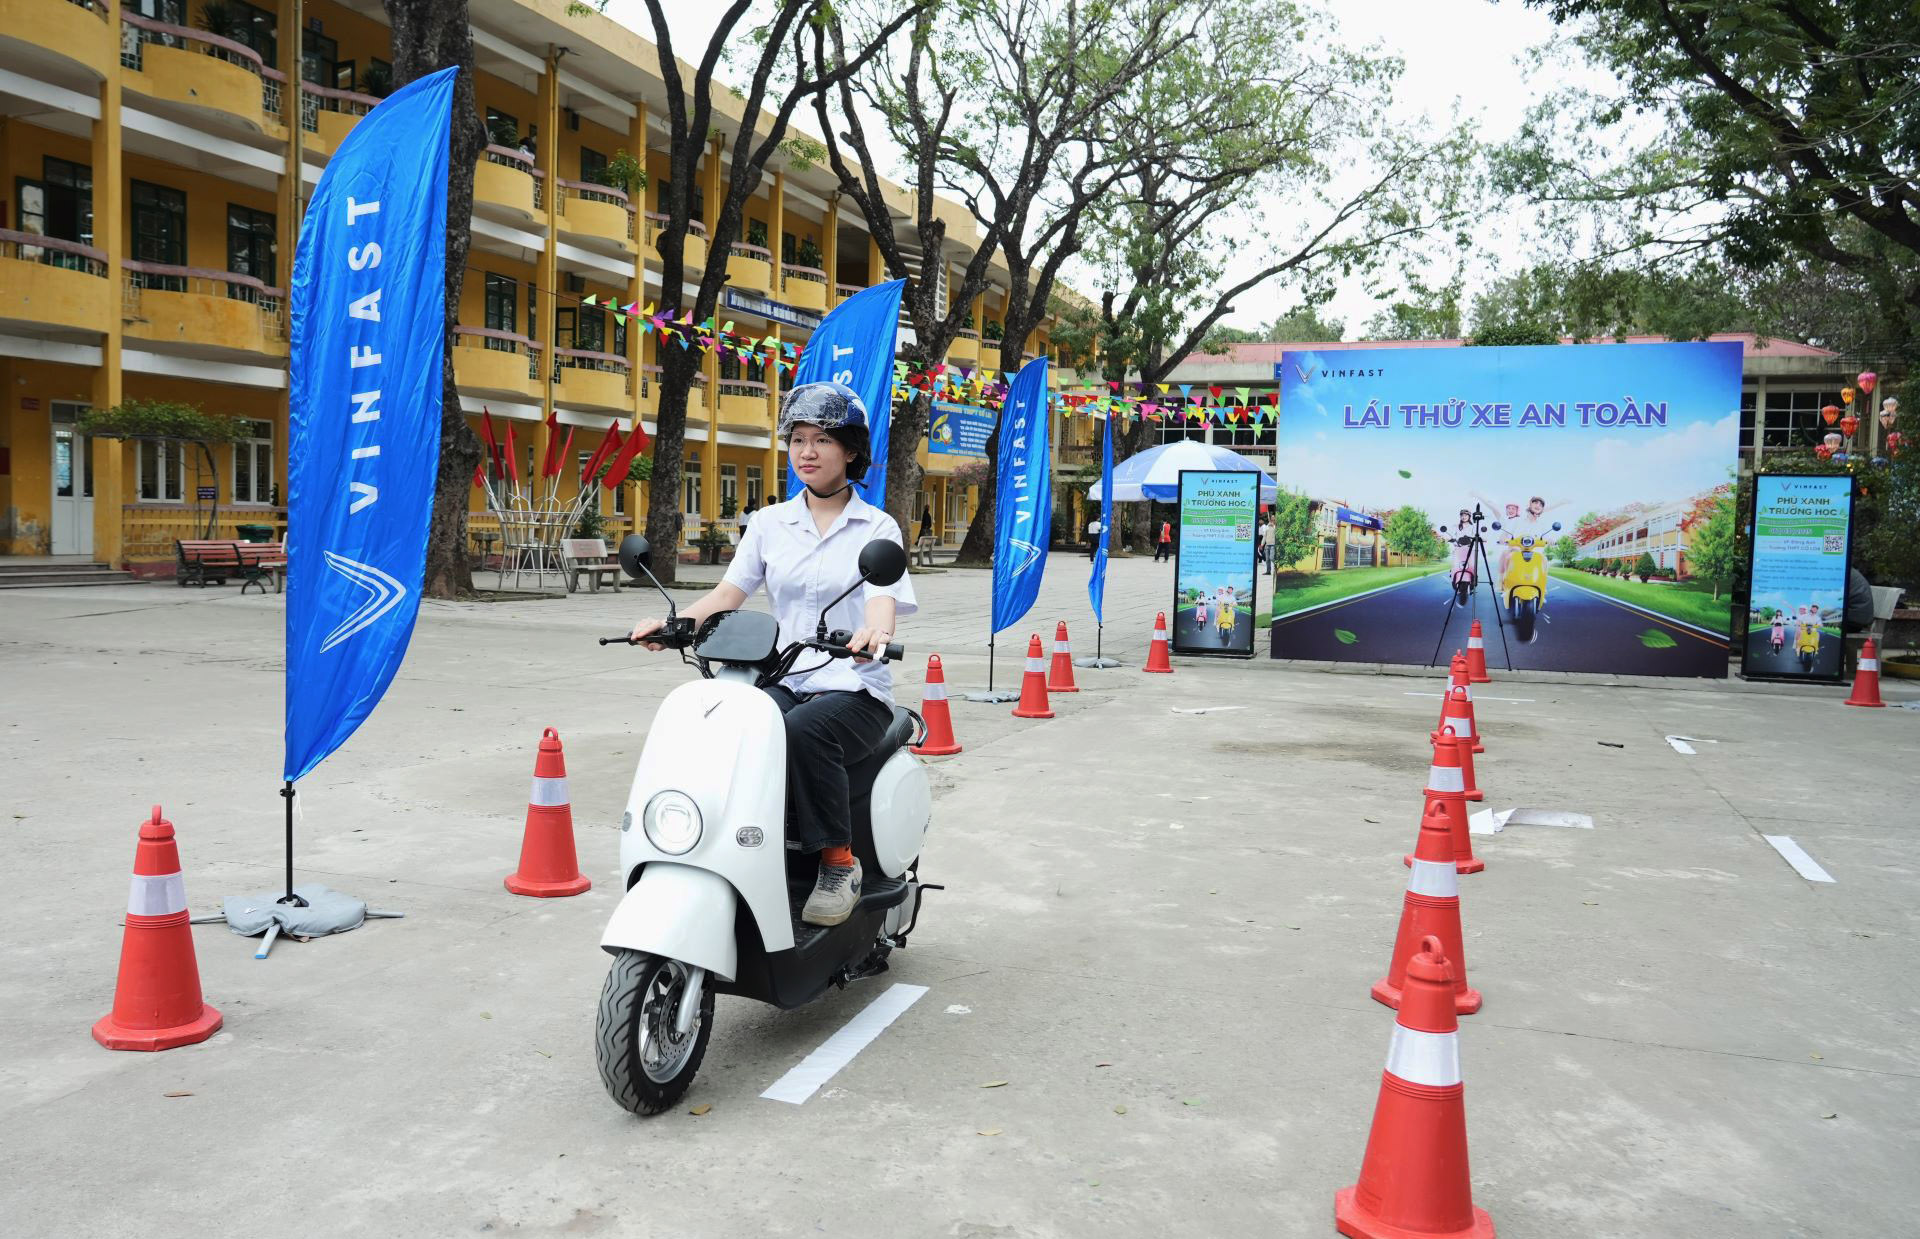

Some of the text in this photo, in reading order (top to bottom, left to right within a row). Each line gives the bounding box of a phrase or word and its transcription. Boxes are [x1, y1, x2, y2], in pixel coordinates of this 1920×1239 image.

[346, 196, 383, 515] VINFAST
[1321, 368, 1385, 378] VINFAST
[1343, 396, 1669, 428] LÁI THỬ XE AN TOÀN
[1012, 400, 1032, 524] VINFAST
[1217, 490, 1240, 498] XANH
